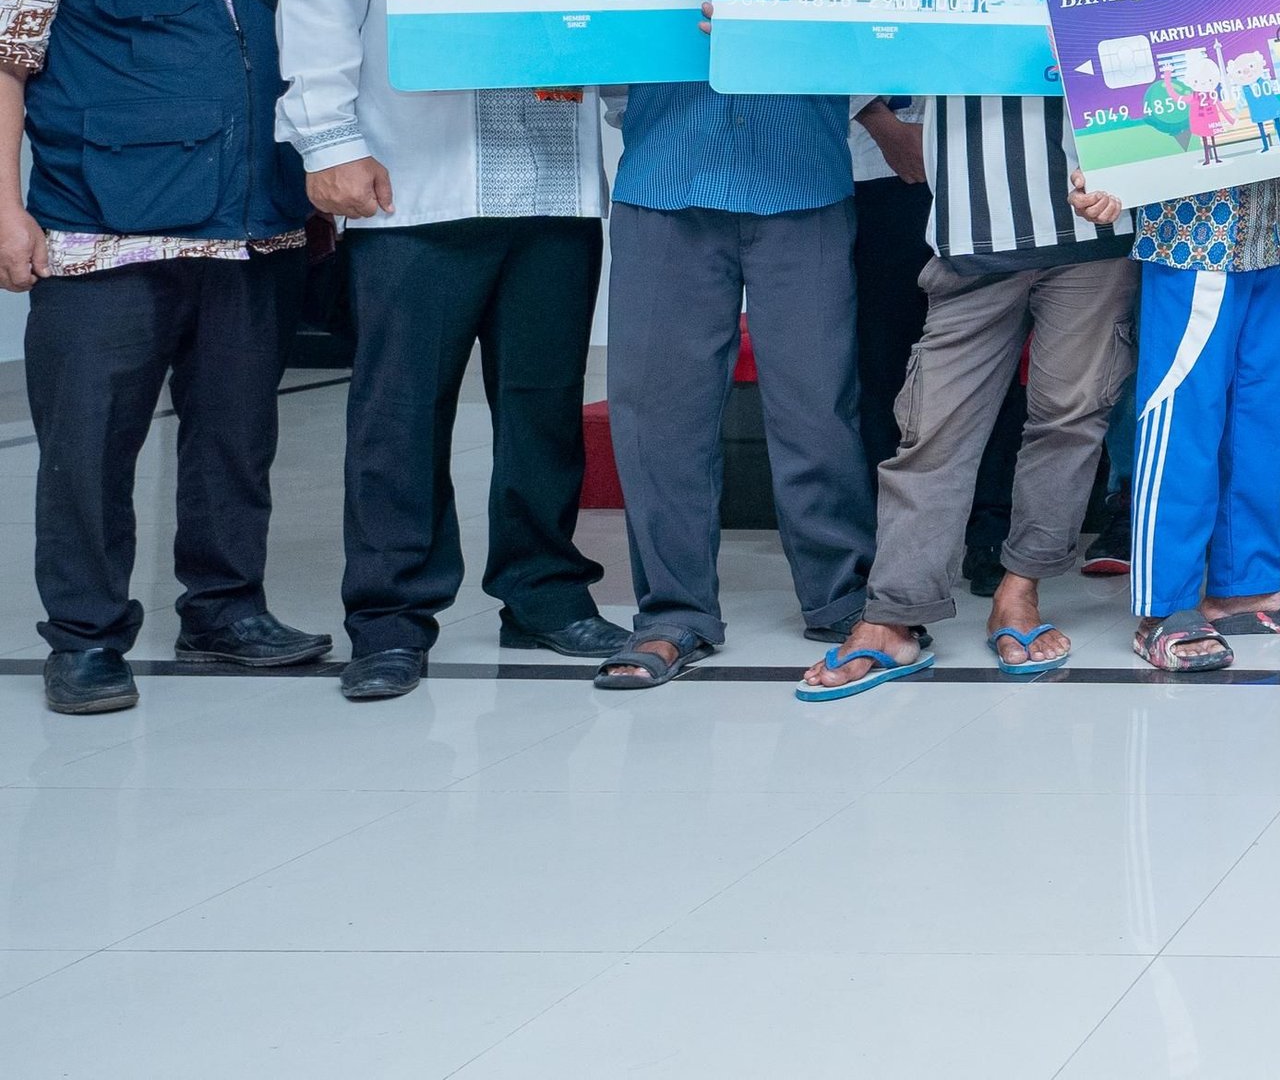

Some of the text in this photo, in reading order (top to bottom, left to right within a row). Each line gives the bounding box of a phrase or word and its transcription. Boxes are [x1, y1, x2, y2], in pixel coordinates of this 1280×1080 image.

[1150, 26, 1195, 44] KARTU
[1198, 18, 1243, 37] LANSIA
[1083, 105, 1129, 127] 5049
[1142, 95, 1187, 117] 4856
